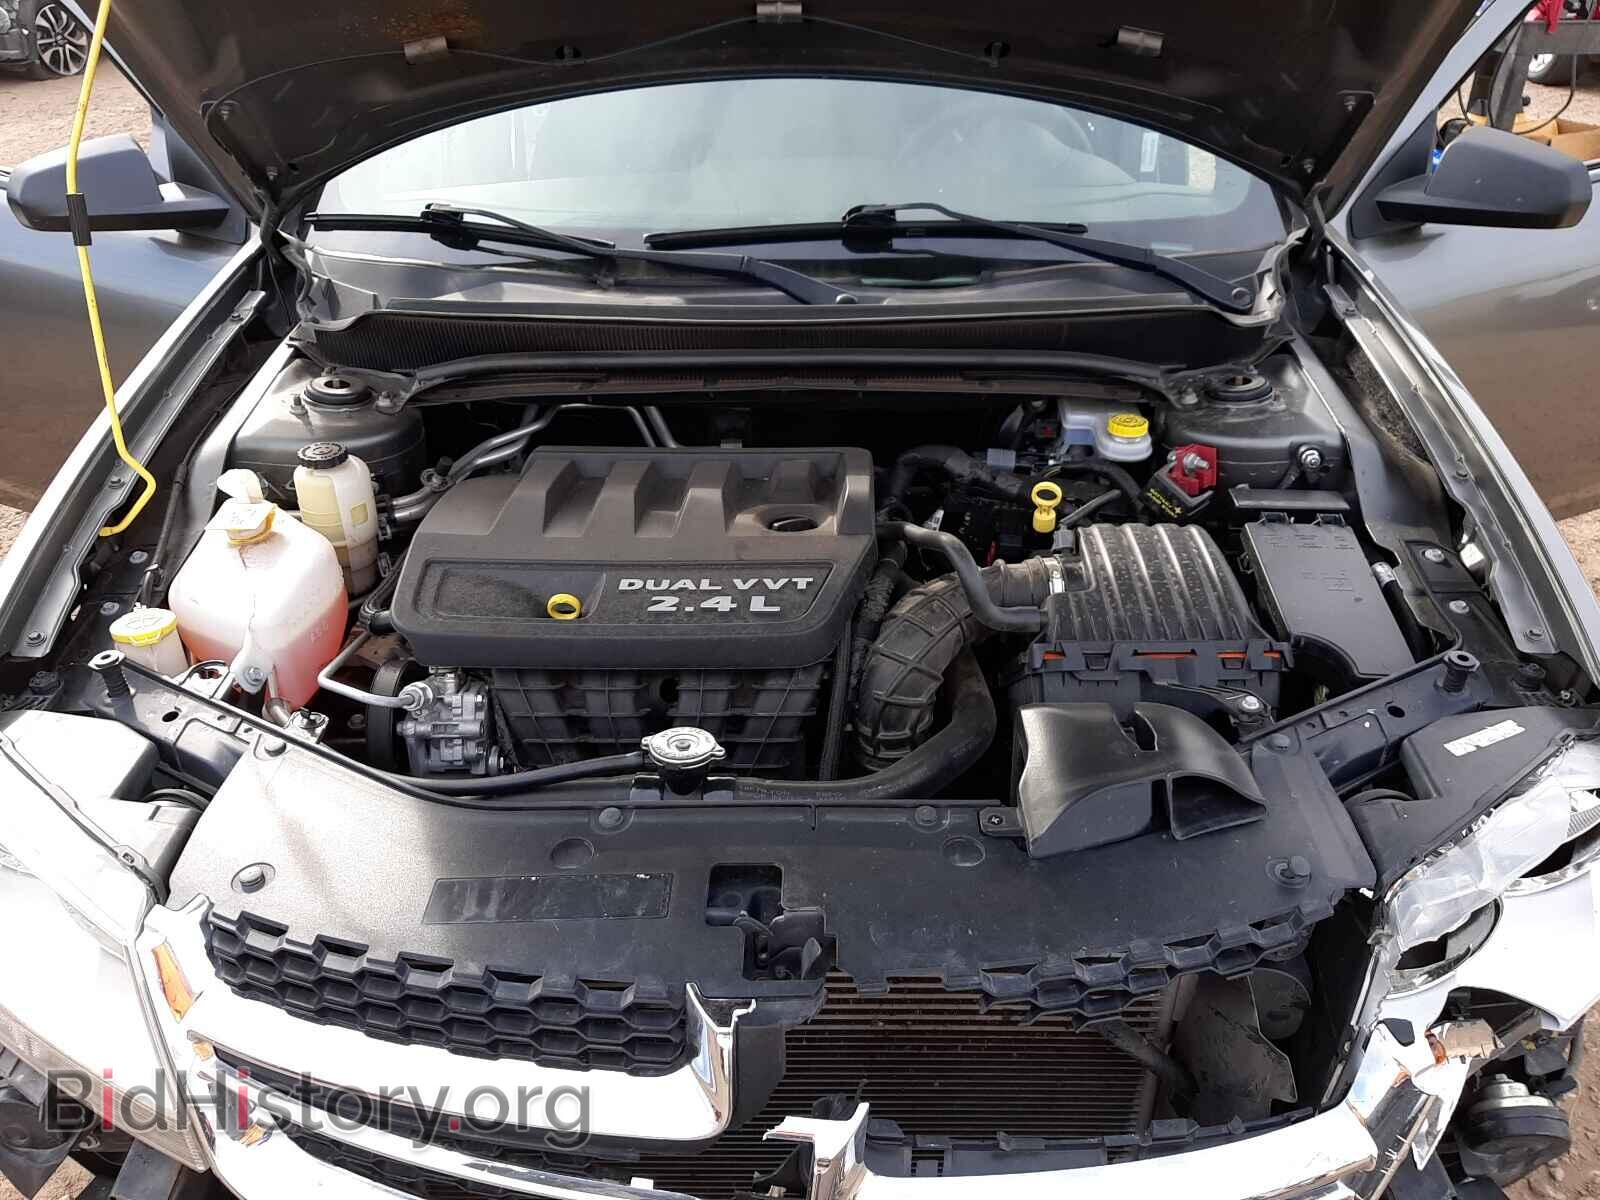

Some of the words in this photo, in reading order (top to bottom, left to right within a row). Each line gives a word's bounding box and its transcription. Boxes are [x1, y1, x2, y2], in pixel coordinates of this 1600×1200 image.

[618, 578, 722, 591] DUAL
[732, 577, 814, 590] VVT
[647, 595, 738, 612] 2.4
